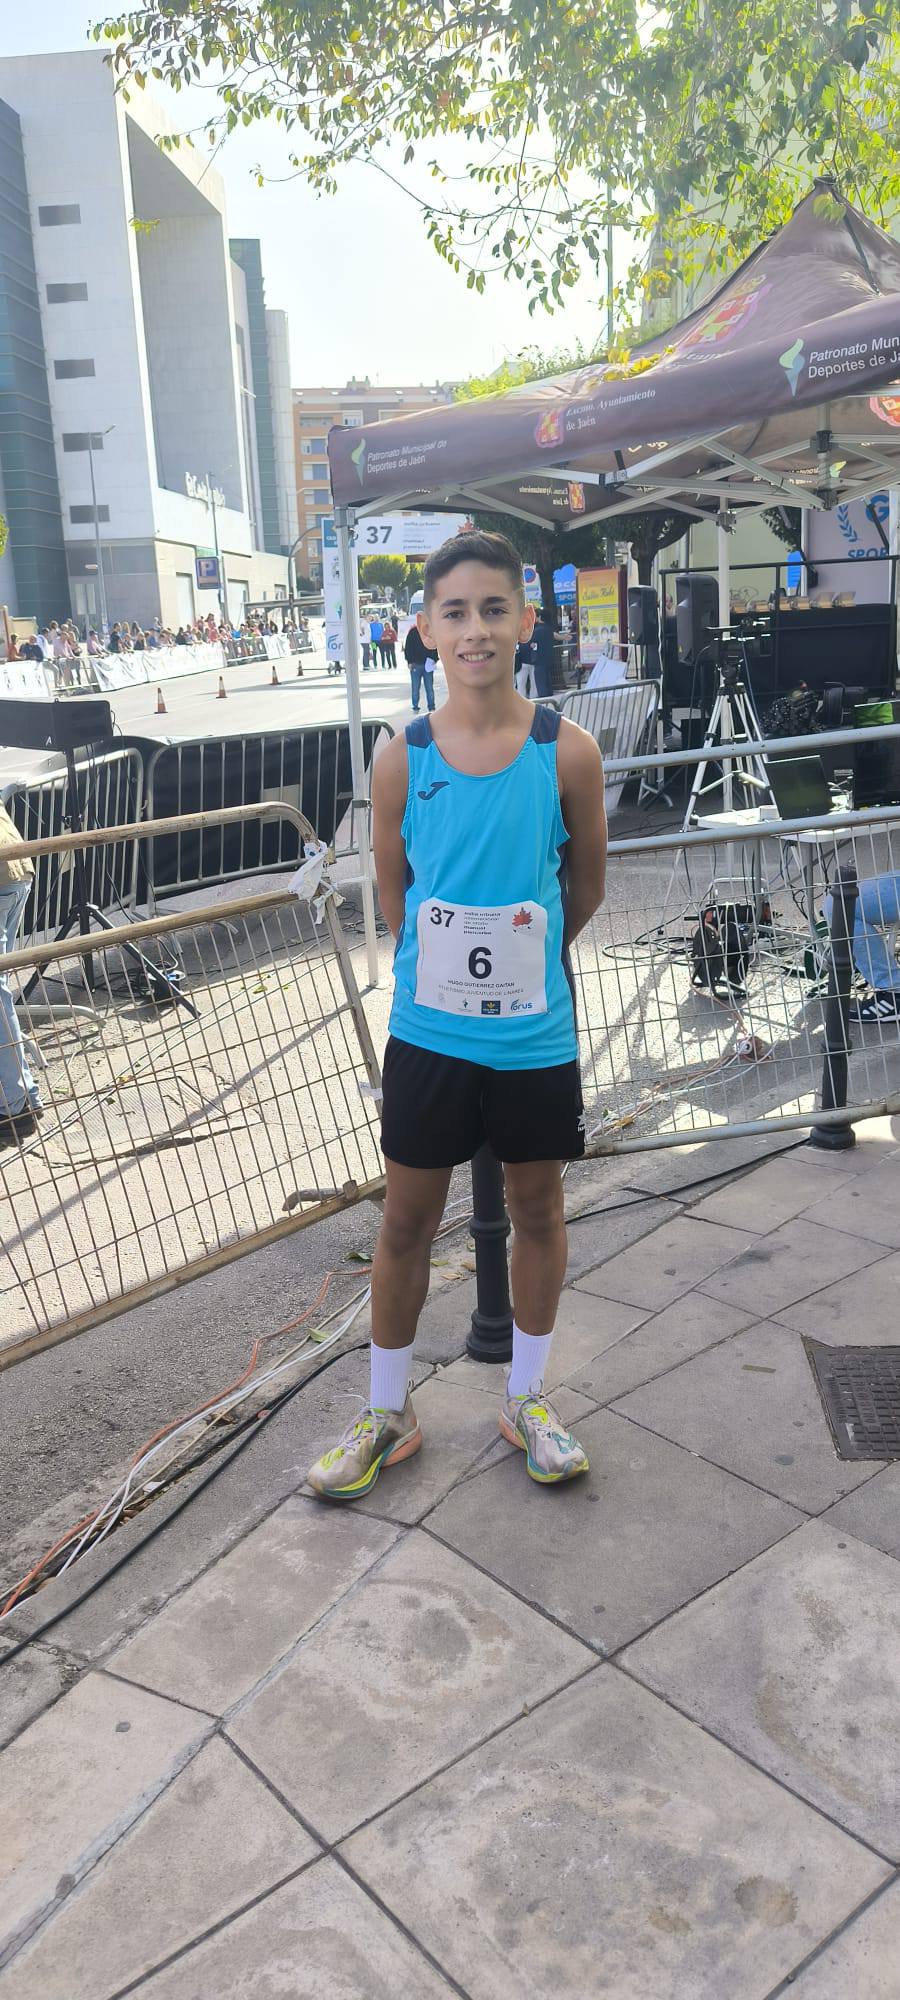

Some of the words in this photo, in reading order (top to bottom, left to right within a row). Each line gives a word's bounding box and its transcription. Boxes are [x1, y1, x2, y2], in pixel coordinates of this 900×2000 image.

[809, 343, 868, 363] Patronato
[871, 337, 900, 351] Mun
[808, 359, 866, 379] Deportes
[869, 354, 886, 367] de
[597, 388, 656, 410] Ayuntamiento
[566, 421, 576, 431] de
[577, 416, 596, 430] Jaén
[367, 460, 397, 474] Deportes
[398, 457, 408, 467] de
[408, 455, 426, 466] Jaén
[368, 449, 400, 463] Patronato
[366, 526, 392, 544] 37
[200, 562, 215, 577] P
[430, 906, 455, 928] 37
[468, 946, 492, 979] 6
